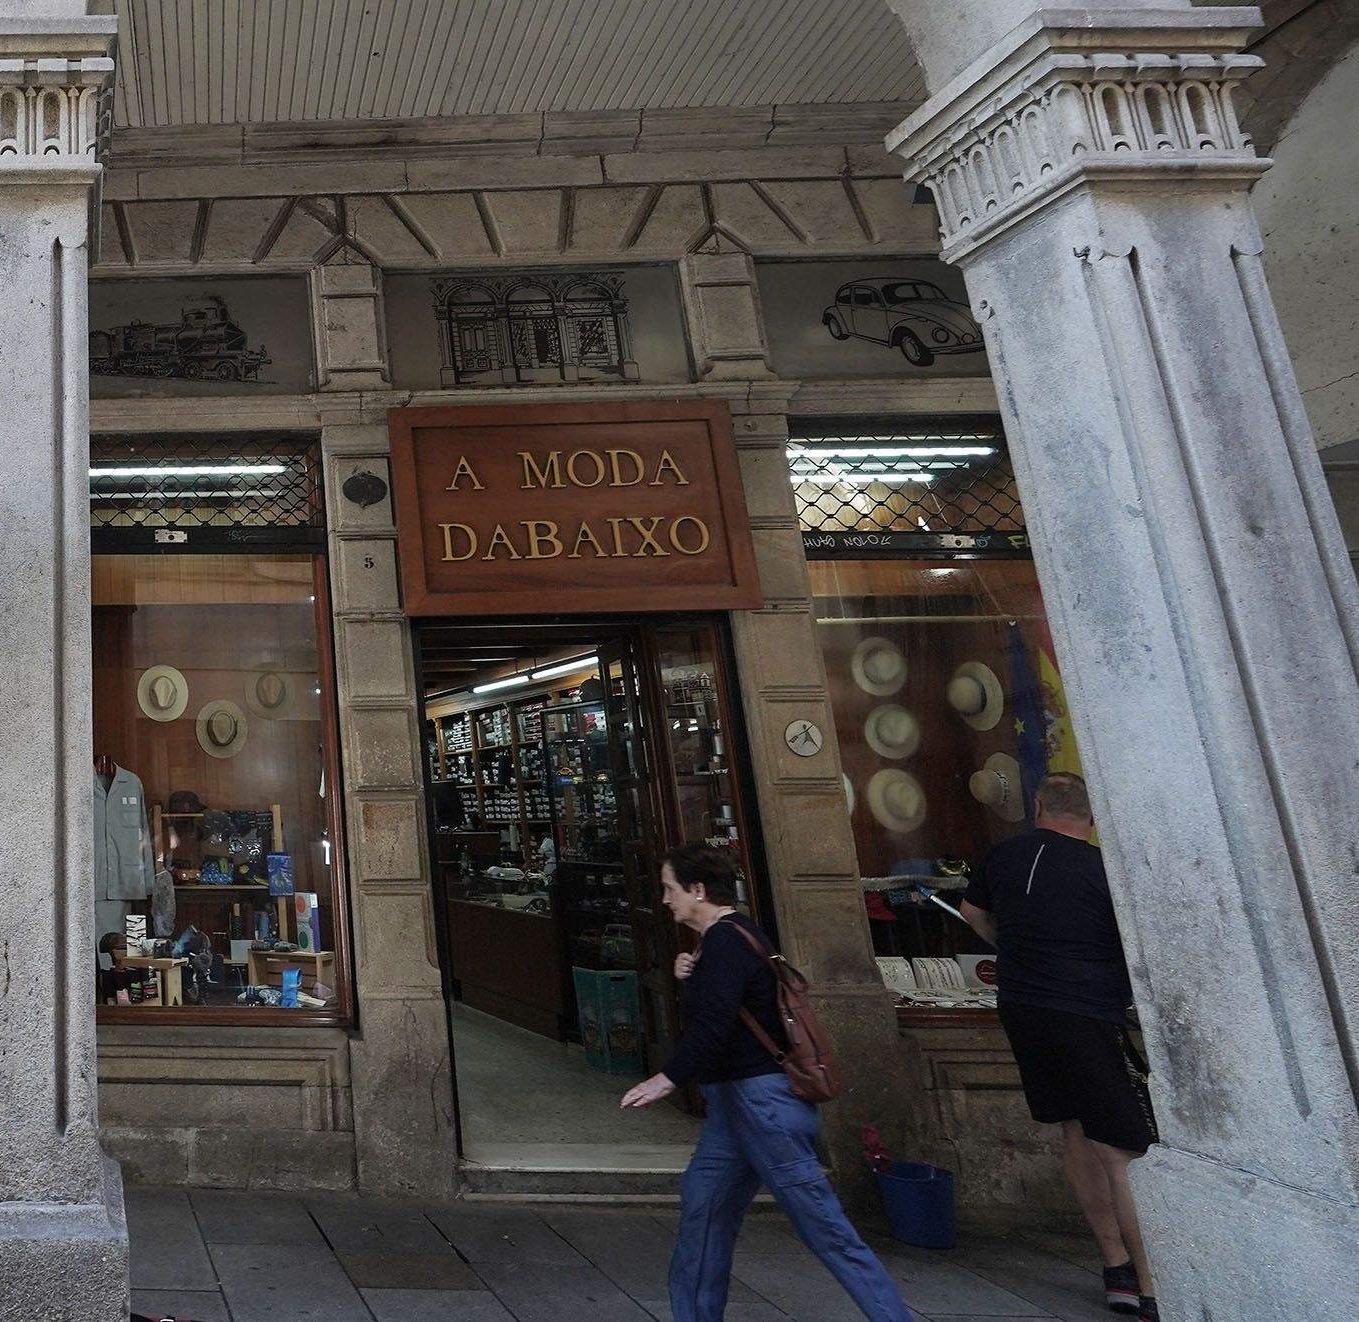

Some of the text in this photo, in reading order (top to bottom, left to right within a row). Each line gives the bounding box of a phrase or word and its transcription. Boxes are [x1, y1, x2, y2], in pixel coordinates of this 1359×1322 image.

[445, 449, 690, 490] A MODA
[437, 516, 711, 562] DABAIXO
[364, 556, 375, 570] 5
